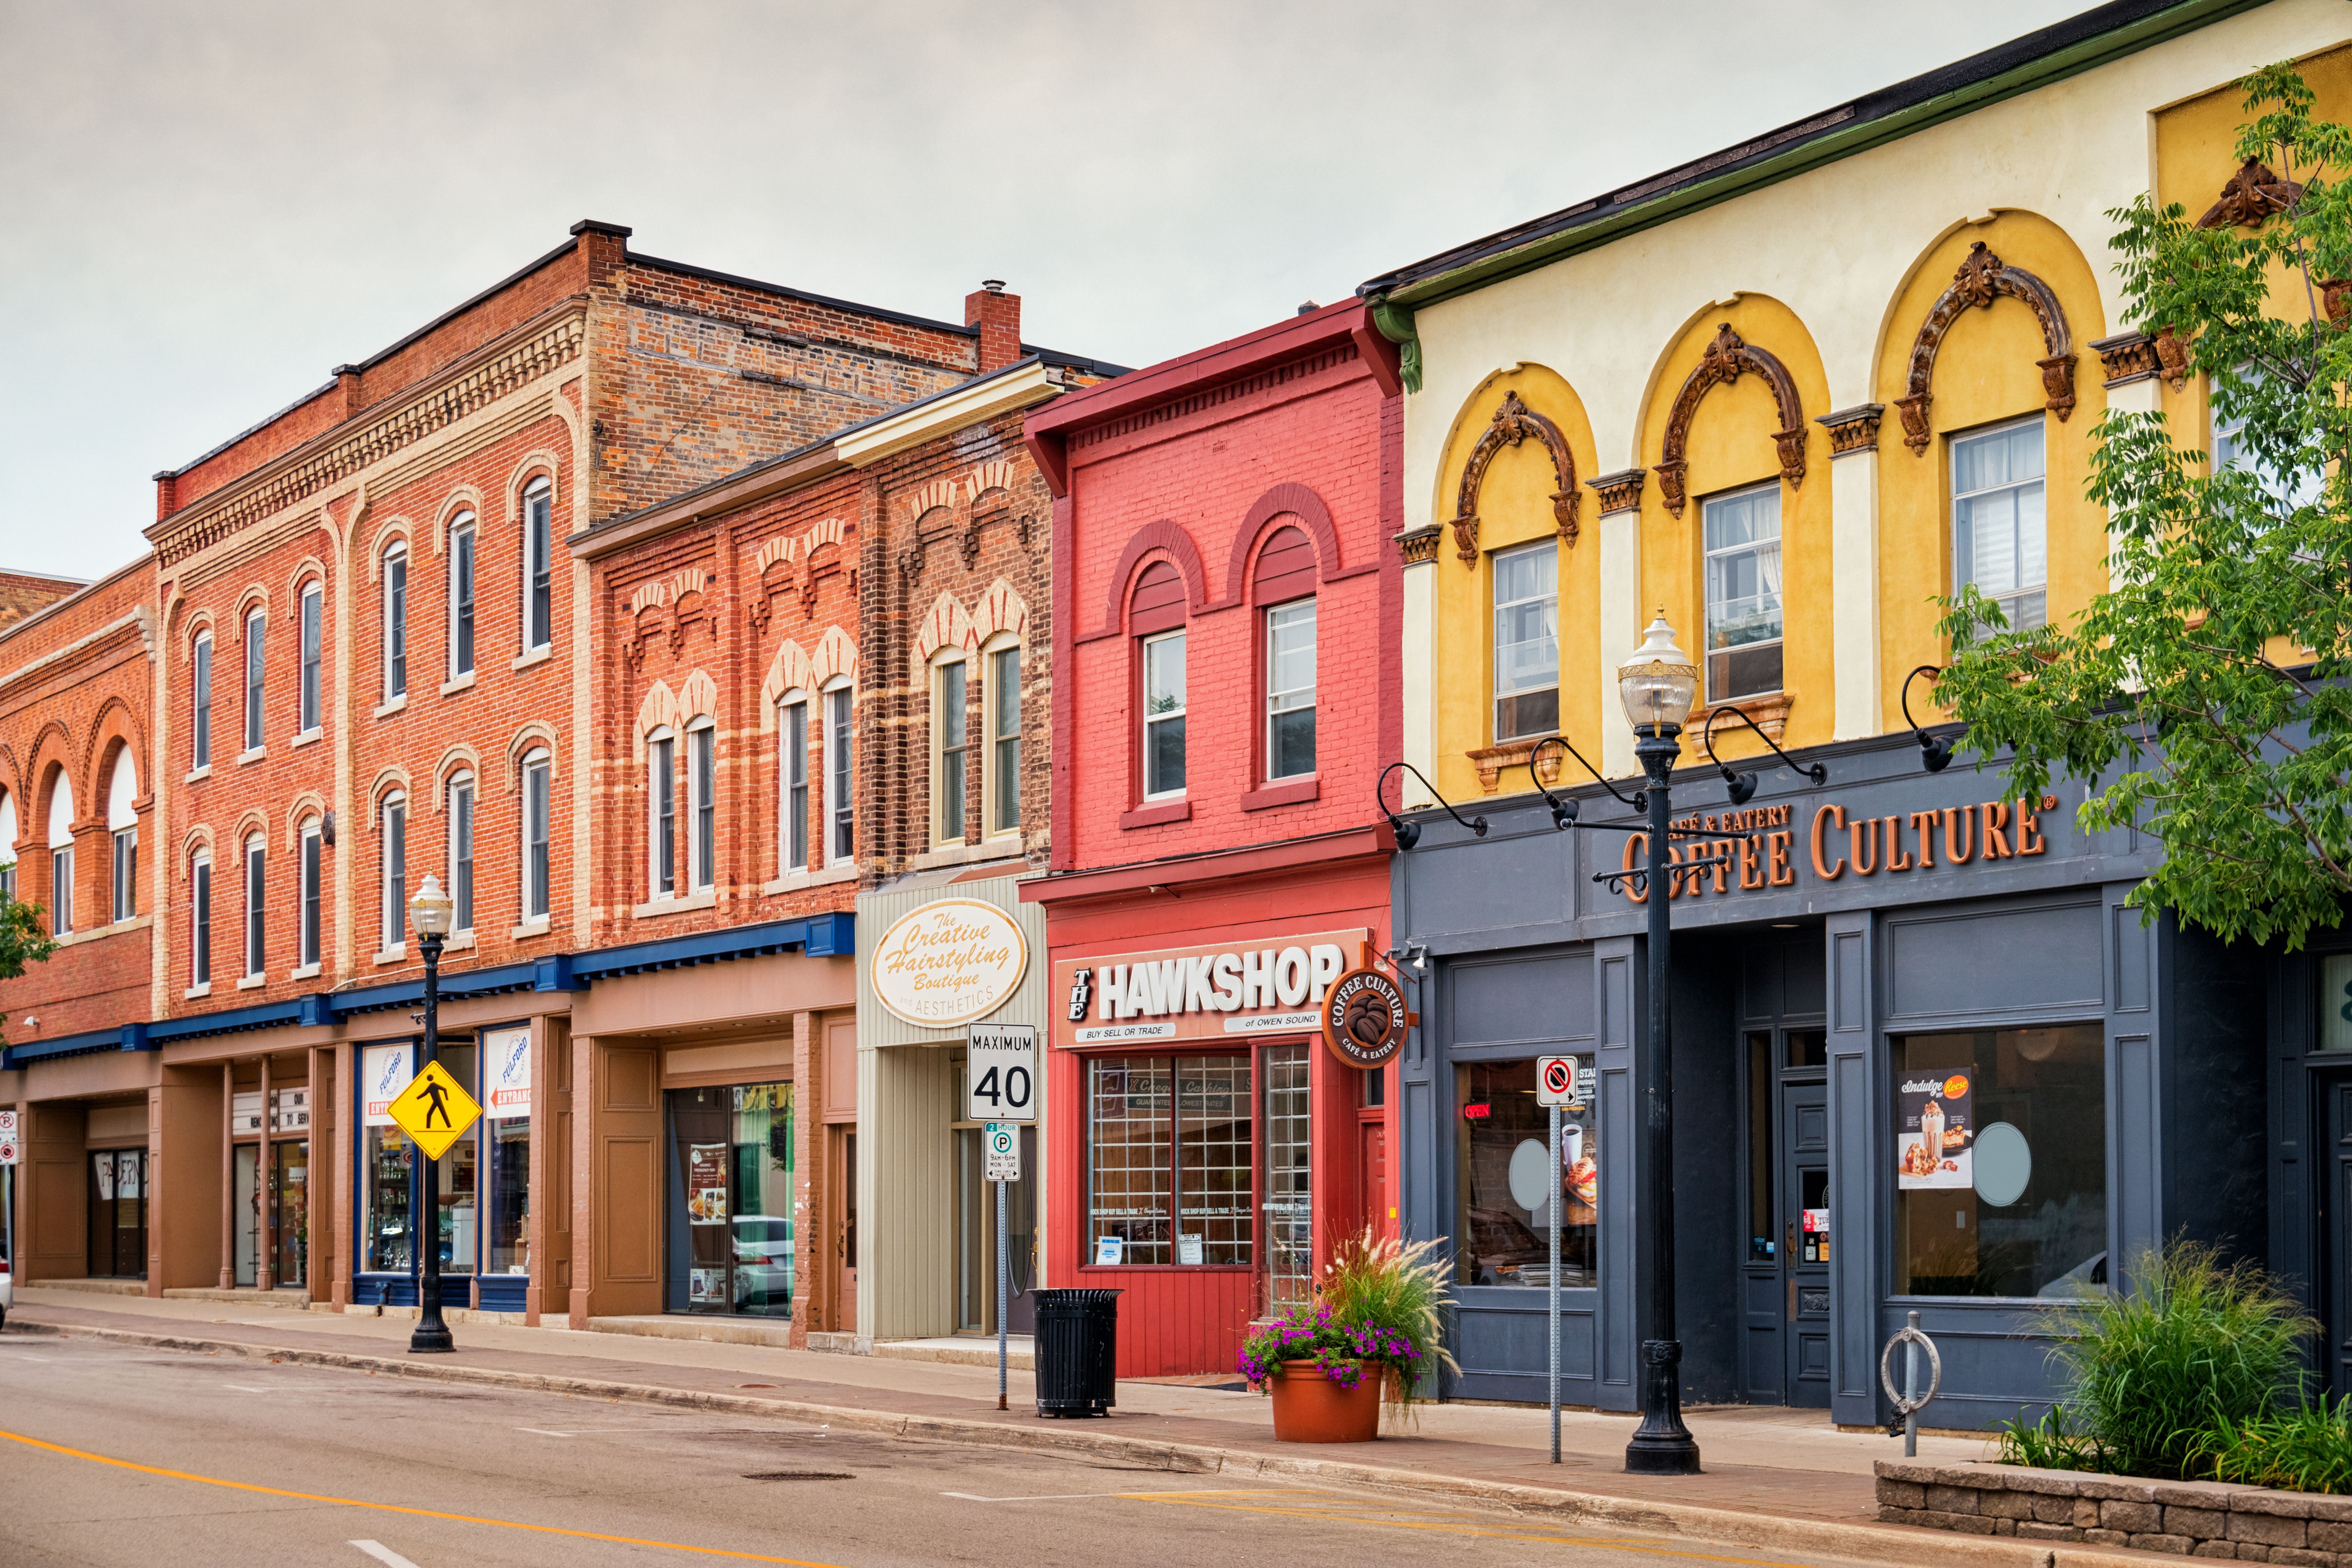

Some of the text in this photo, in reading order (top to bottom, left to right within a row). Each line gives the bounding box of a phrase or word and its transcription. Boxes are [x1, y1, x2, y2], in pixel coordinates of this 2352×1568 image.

[1669, 804, 1791, 840] AFÉ & EATERY
[934, 912, 956, 928] The
[903, 924, 990, 954] Creative
[885, 943, 1010, 974] Hairstyling
[914, 973, 979, 993] Boutique
[1067, 944, 1343, 1020] THE HAWKSHOP
[900, 985, 993, 1016] and AESTHETICS
[1333, 975, 1404, 1028] COFFEE CULTURE
[1286, 1016, 1316, 1024] SOUND
[973, 1036, 1031, 1051] MAXIMUM
[1087, 1030, 1101, 1038] BUY
[1343, 1038, 1360, 1056] CAFÉ
[1370, 1038, 1396, 1059] EATERY
[503, 1036, 527, 1083] FULFORD
[379, 1052, 402, 1095] FULFORD
[974, 1066, 1030, 1107] 40
[1902, 1079, 1943, 1097] Indulge
[1945, 1080, 1967, 1094] Reese
[294, 1093, 303, 1104] OUR
[498, 1090, 531, 1104] ENTRANC
[287, 1114, 293, 1125] TO
[298, 1113, 309, 1124] SERV
[1465, 1103, 1490, 1118] OPEN
[1818, 1217, 1829, 1225] TUE
